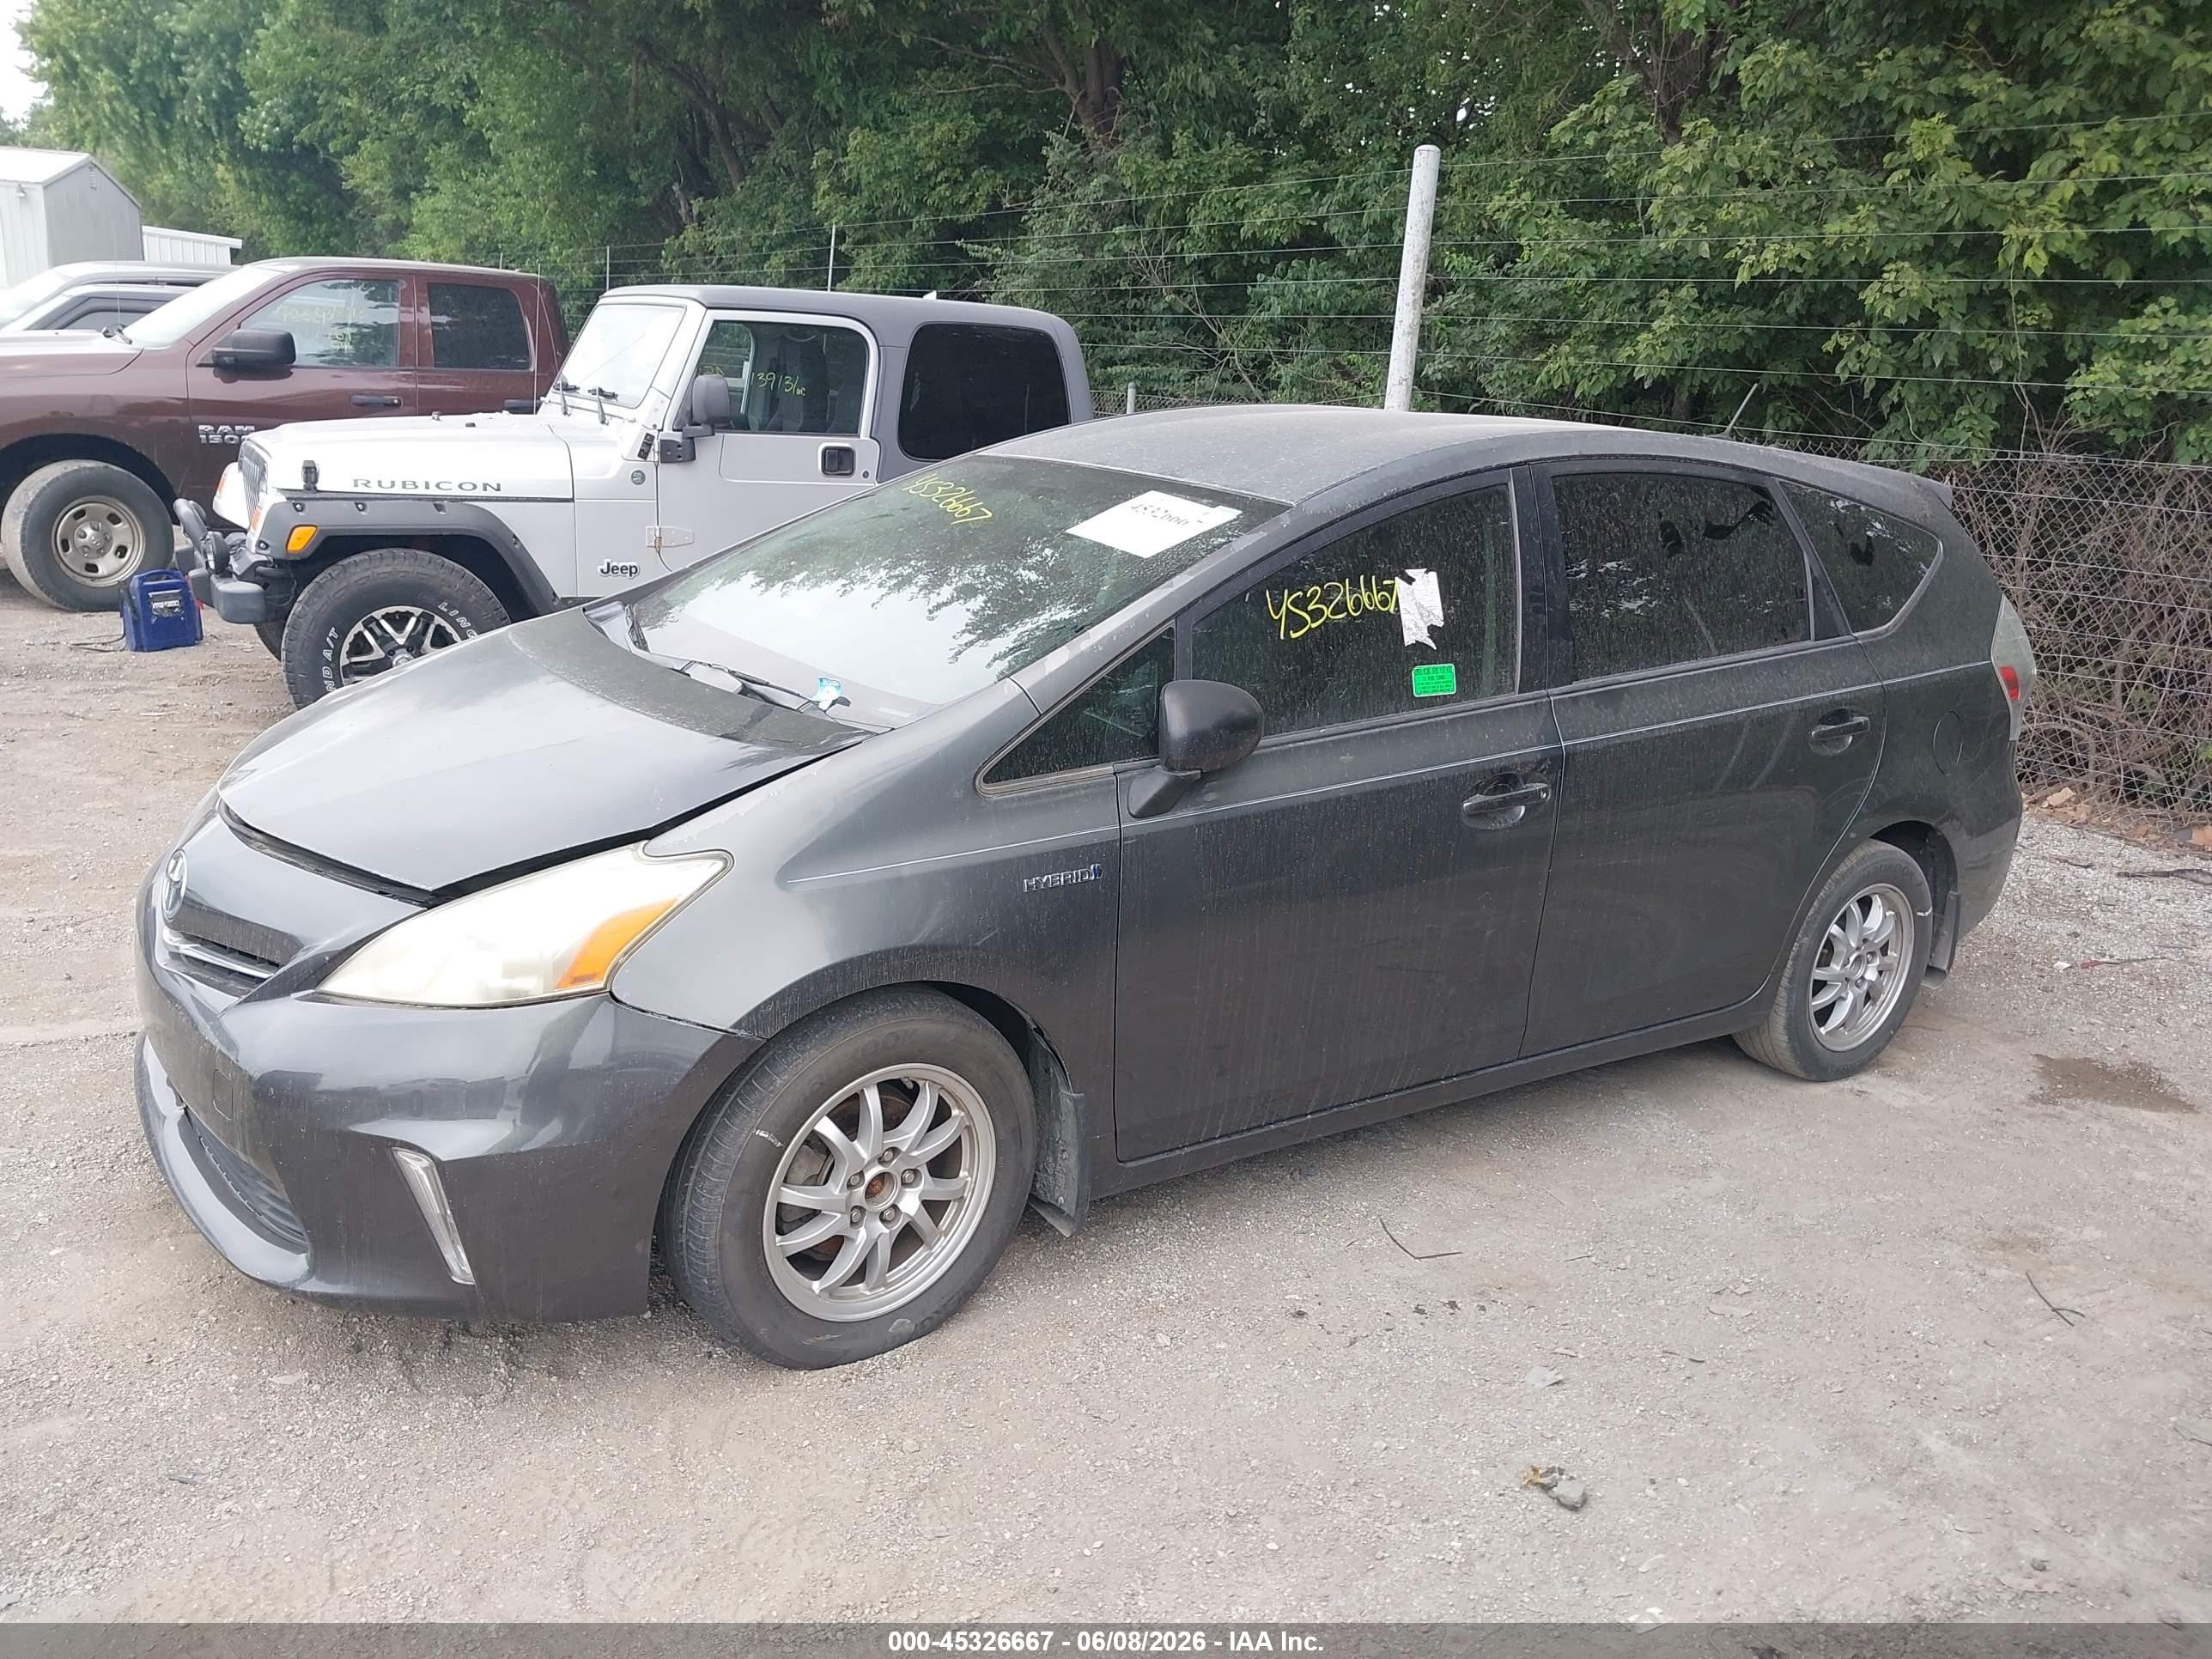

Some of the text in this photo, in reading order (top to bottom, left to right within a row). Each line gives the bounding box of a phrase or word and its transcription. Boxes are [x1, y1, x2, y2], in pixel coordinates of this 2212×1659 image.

[198, 424, 255, 434] RAM
[353, 478, 501, 492] RUBICON
[902, 473, 992, 526] 45326667
[599, 560, 639, 578] Jeep
[1023, 868, 1092, 892] HYBRID
